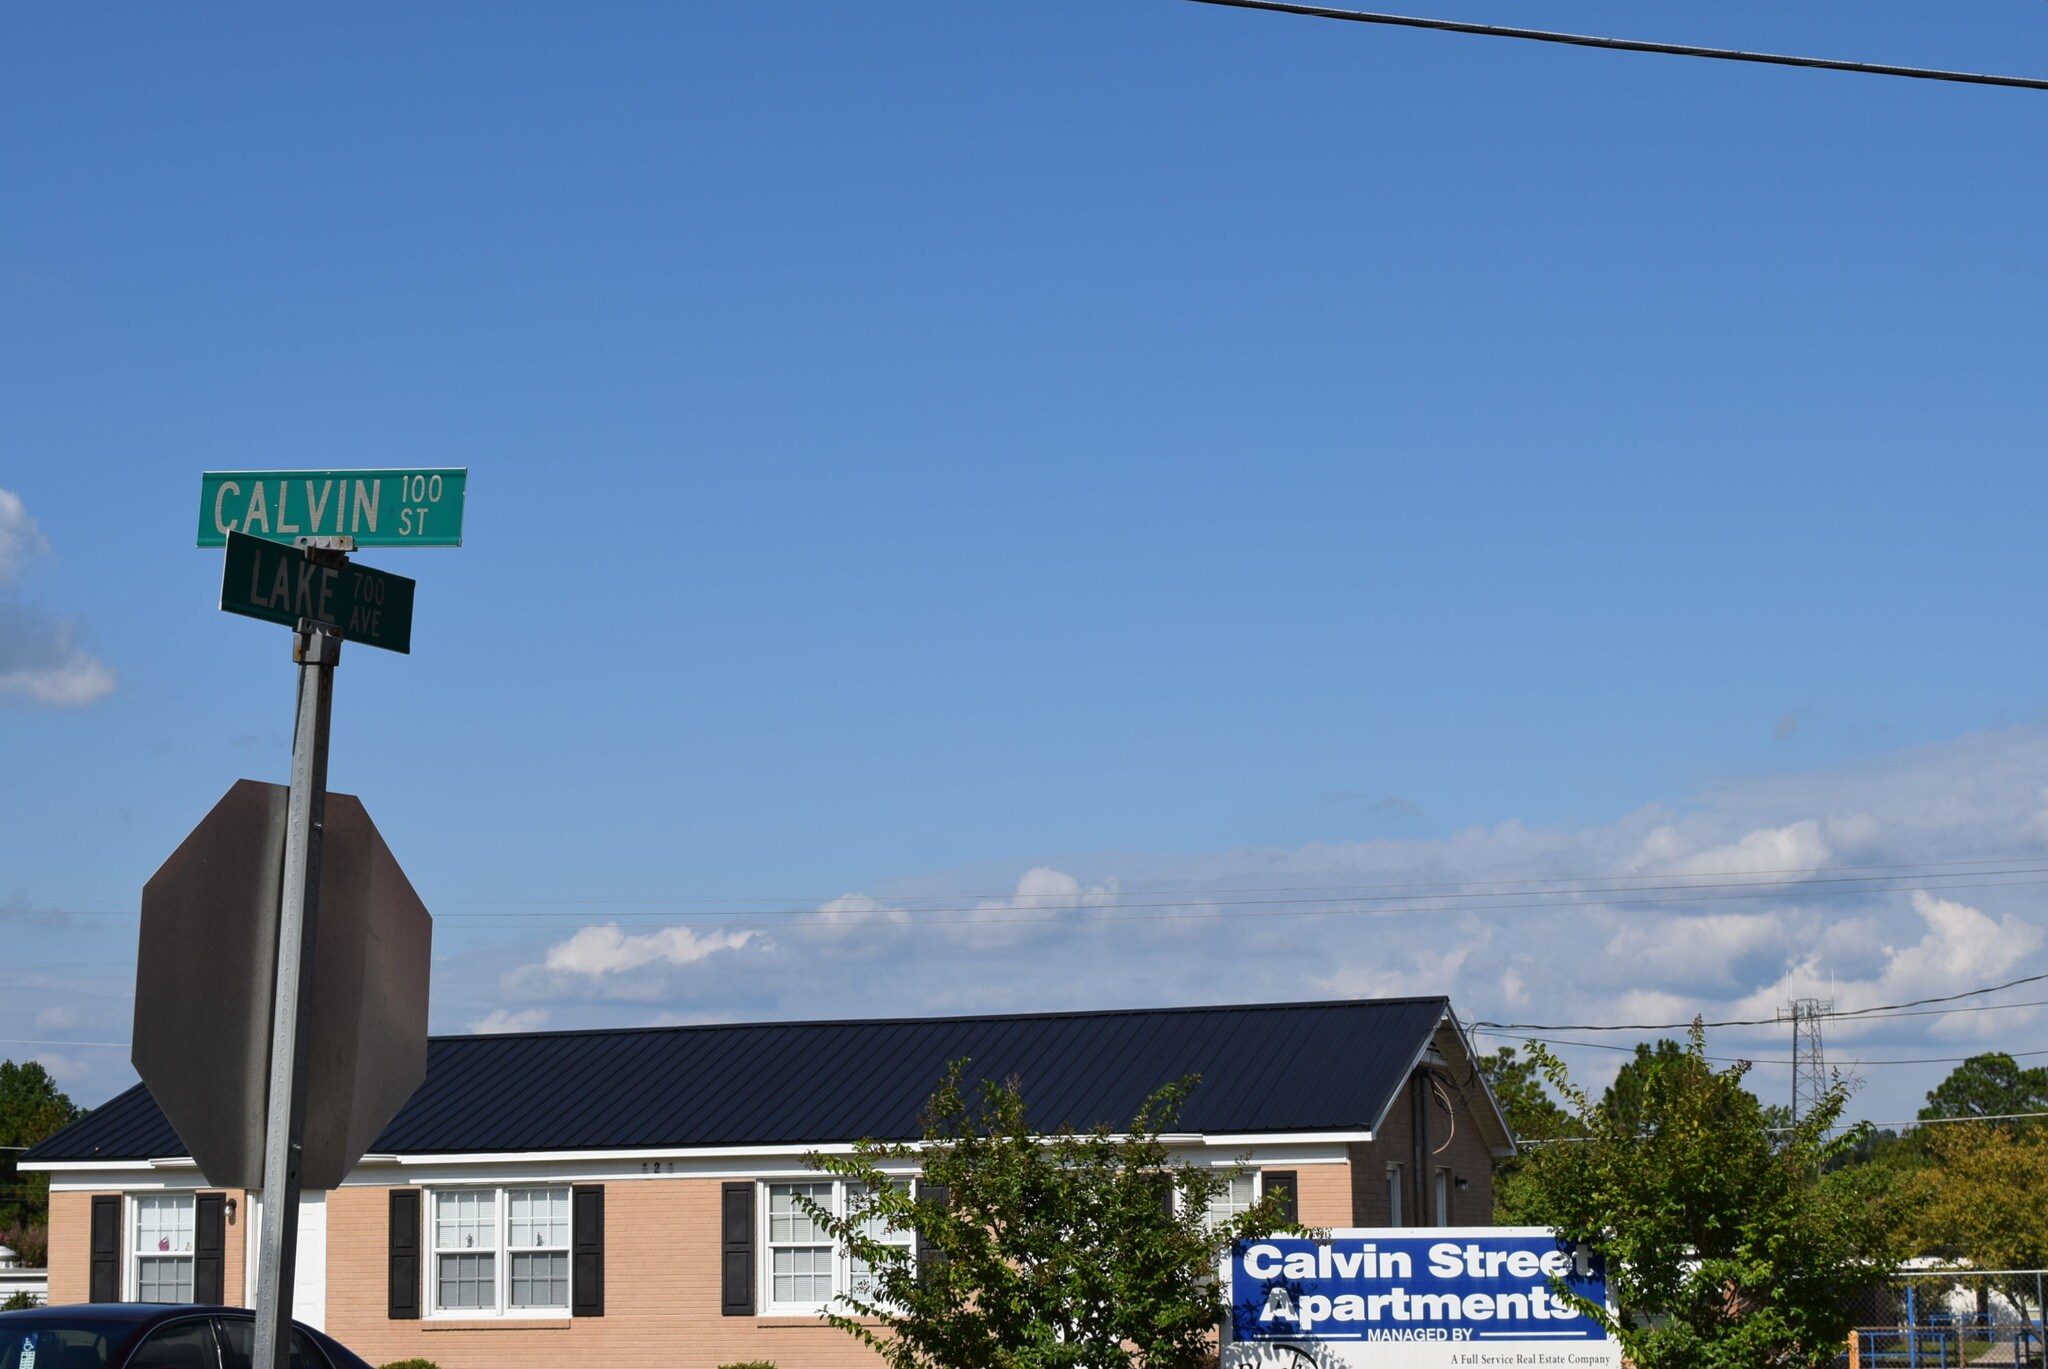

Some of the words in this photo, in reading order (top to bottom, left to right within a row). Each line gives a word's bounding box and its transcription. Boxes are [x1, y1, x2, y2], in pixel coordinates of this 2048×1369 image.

[402, 475, 443, 503] 100
[214, 480, 381, 534] CALVIN
[398, 508, 429, 536] ST
[249, 549, 339, 623] LAKE
[353, 572, 386, 606] 700
[350, 606, 381, 638] AVE
[1243, 1243, 1412, 1280] Calvin
[1428, 1243, 1594, 1279] Street
[1259, 1286, 1580, 1330] Apartments
[1368, 1329, 1448, 1343] MANAGED
[1452, 1328, 1473, 1342] BY
[1451, 1355, 1459, 1364] A
[1461, 1355, 1479, 1364] Full
[1481, 1354, 1514, 1364] Service
[1516, 1354, 1536, 1364] Real
[1539, 1354, 1565, 1364] Estate
[1568, 1353, 1610, 1367] Company
